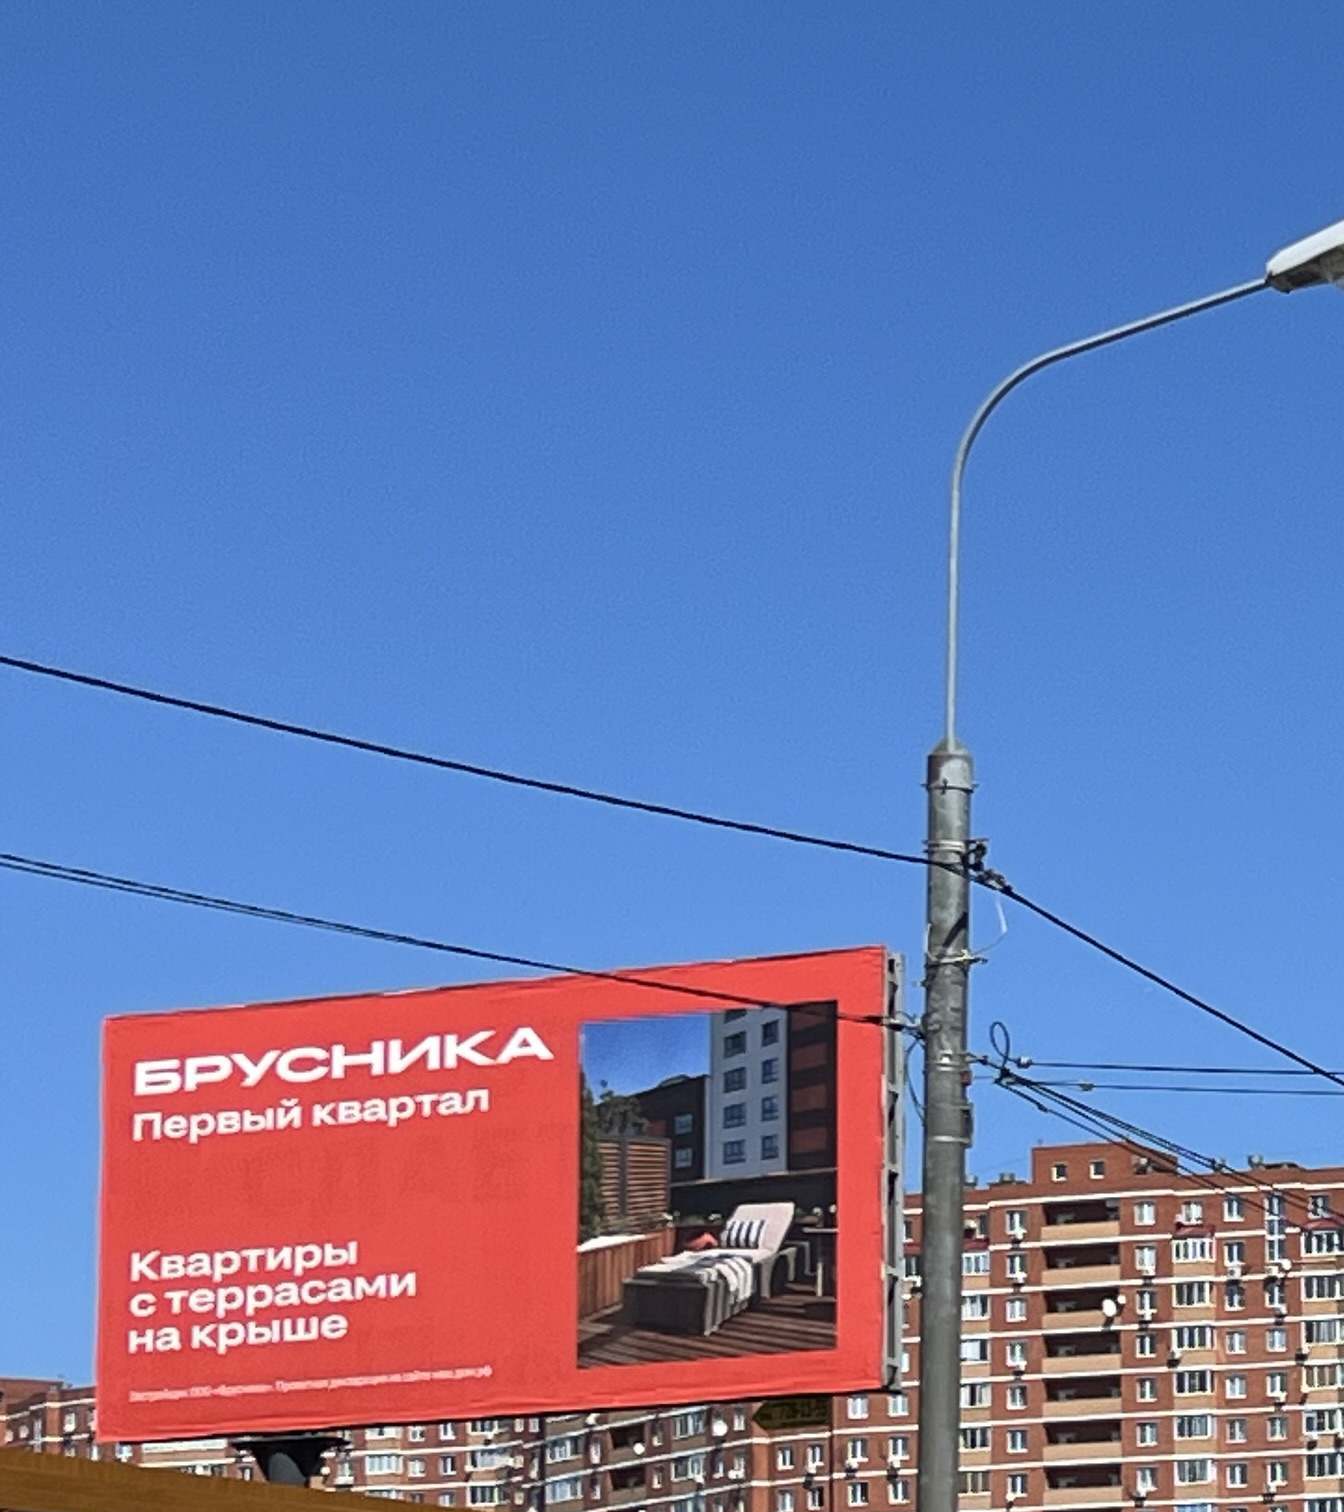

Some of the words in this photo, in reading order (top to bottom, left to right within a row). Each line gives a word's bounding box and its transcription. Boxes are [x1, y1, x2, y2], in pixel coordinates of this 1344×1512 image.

[132, 1026, 555, 1096] БРУСНИКА
[132, 1098, 302, 1144] Первый
[311, 1088, 490, 1127] квартал
[129, 1240, 359, 1283] Квартиры
[129, 1292, 157, 1318] с
[163, 1271, 417, 1319] террасами
[127, 1325, 182, 1354] на
[190, 1313, 349, 1355] крыше
